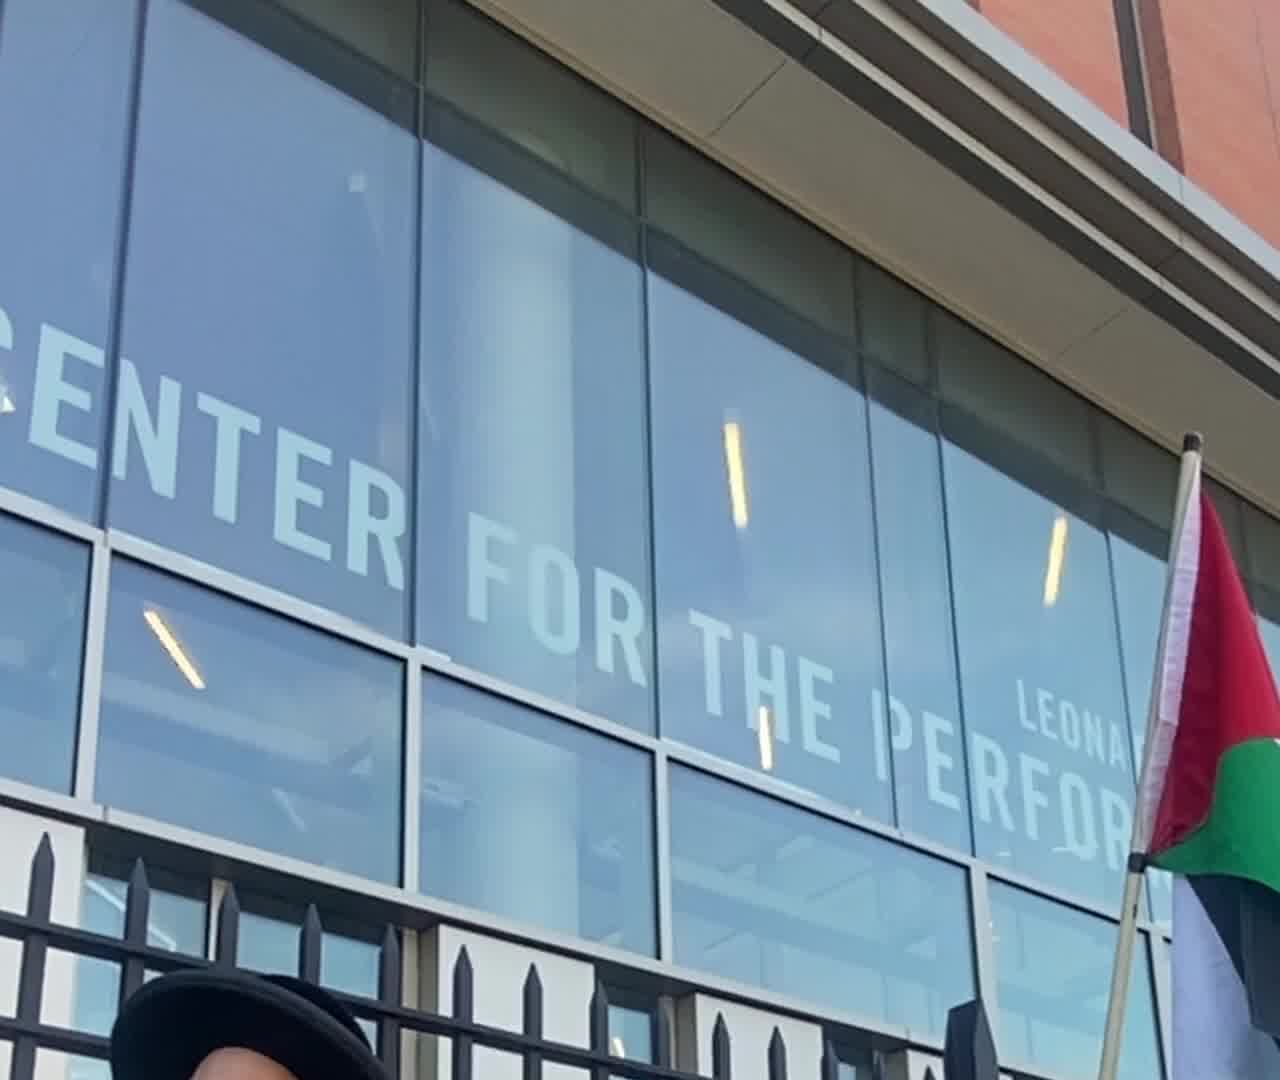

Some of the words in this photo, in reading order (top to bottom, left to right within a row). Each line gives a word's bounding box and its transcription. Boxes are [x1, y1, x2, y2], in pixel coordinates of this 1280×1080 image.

[465, 512, 647, 689] FOR
[688, 609, 841, 764] THE
[871, 688, 1160, 882] PERFOR
[1017, 680, 1144, 772] LEONA
